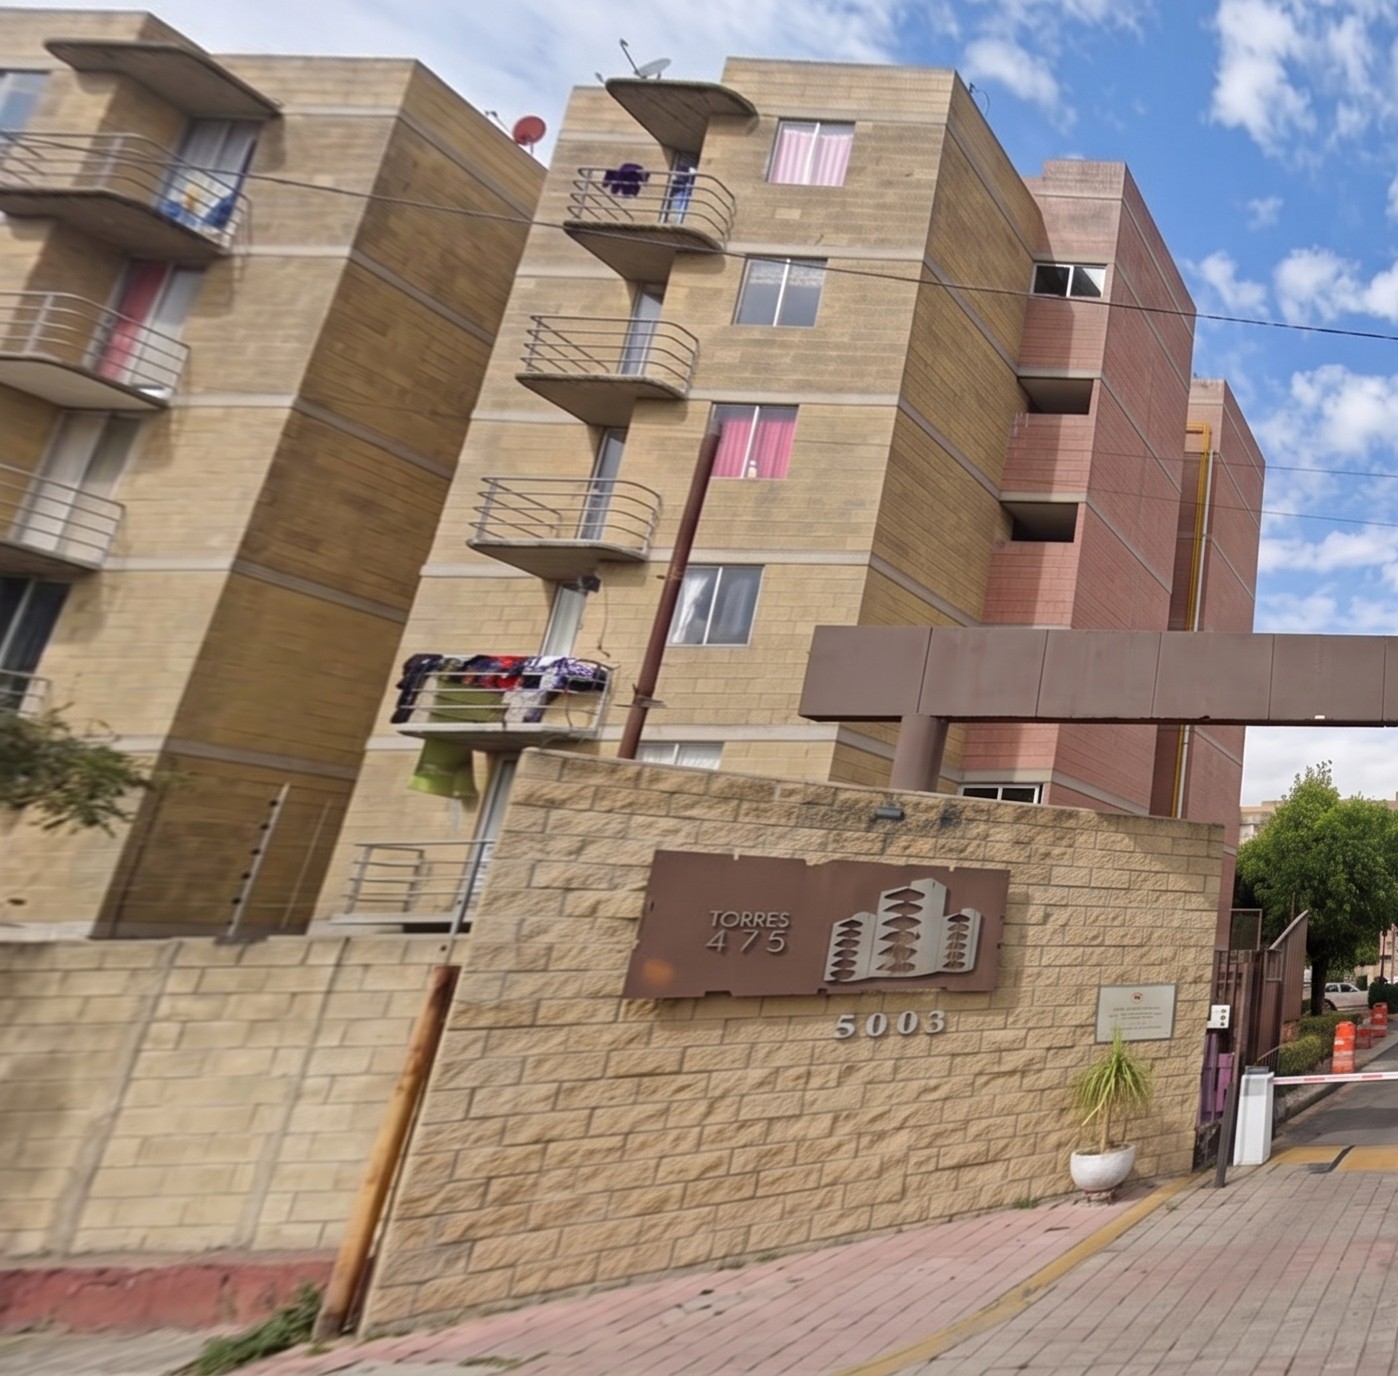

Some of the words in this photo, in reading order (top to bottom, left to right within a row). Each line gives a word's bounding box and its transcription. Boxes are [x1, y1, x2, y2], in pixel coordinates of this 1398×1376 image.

[709, 910, 790, 928] TORRES
[705, 929, 786, 953] 475
[833, 1010, 946, 1039] 5003
